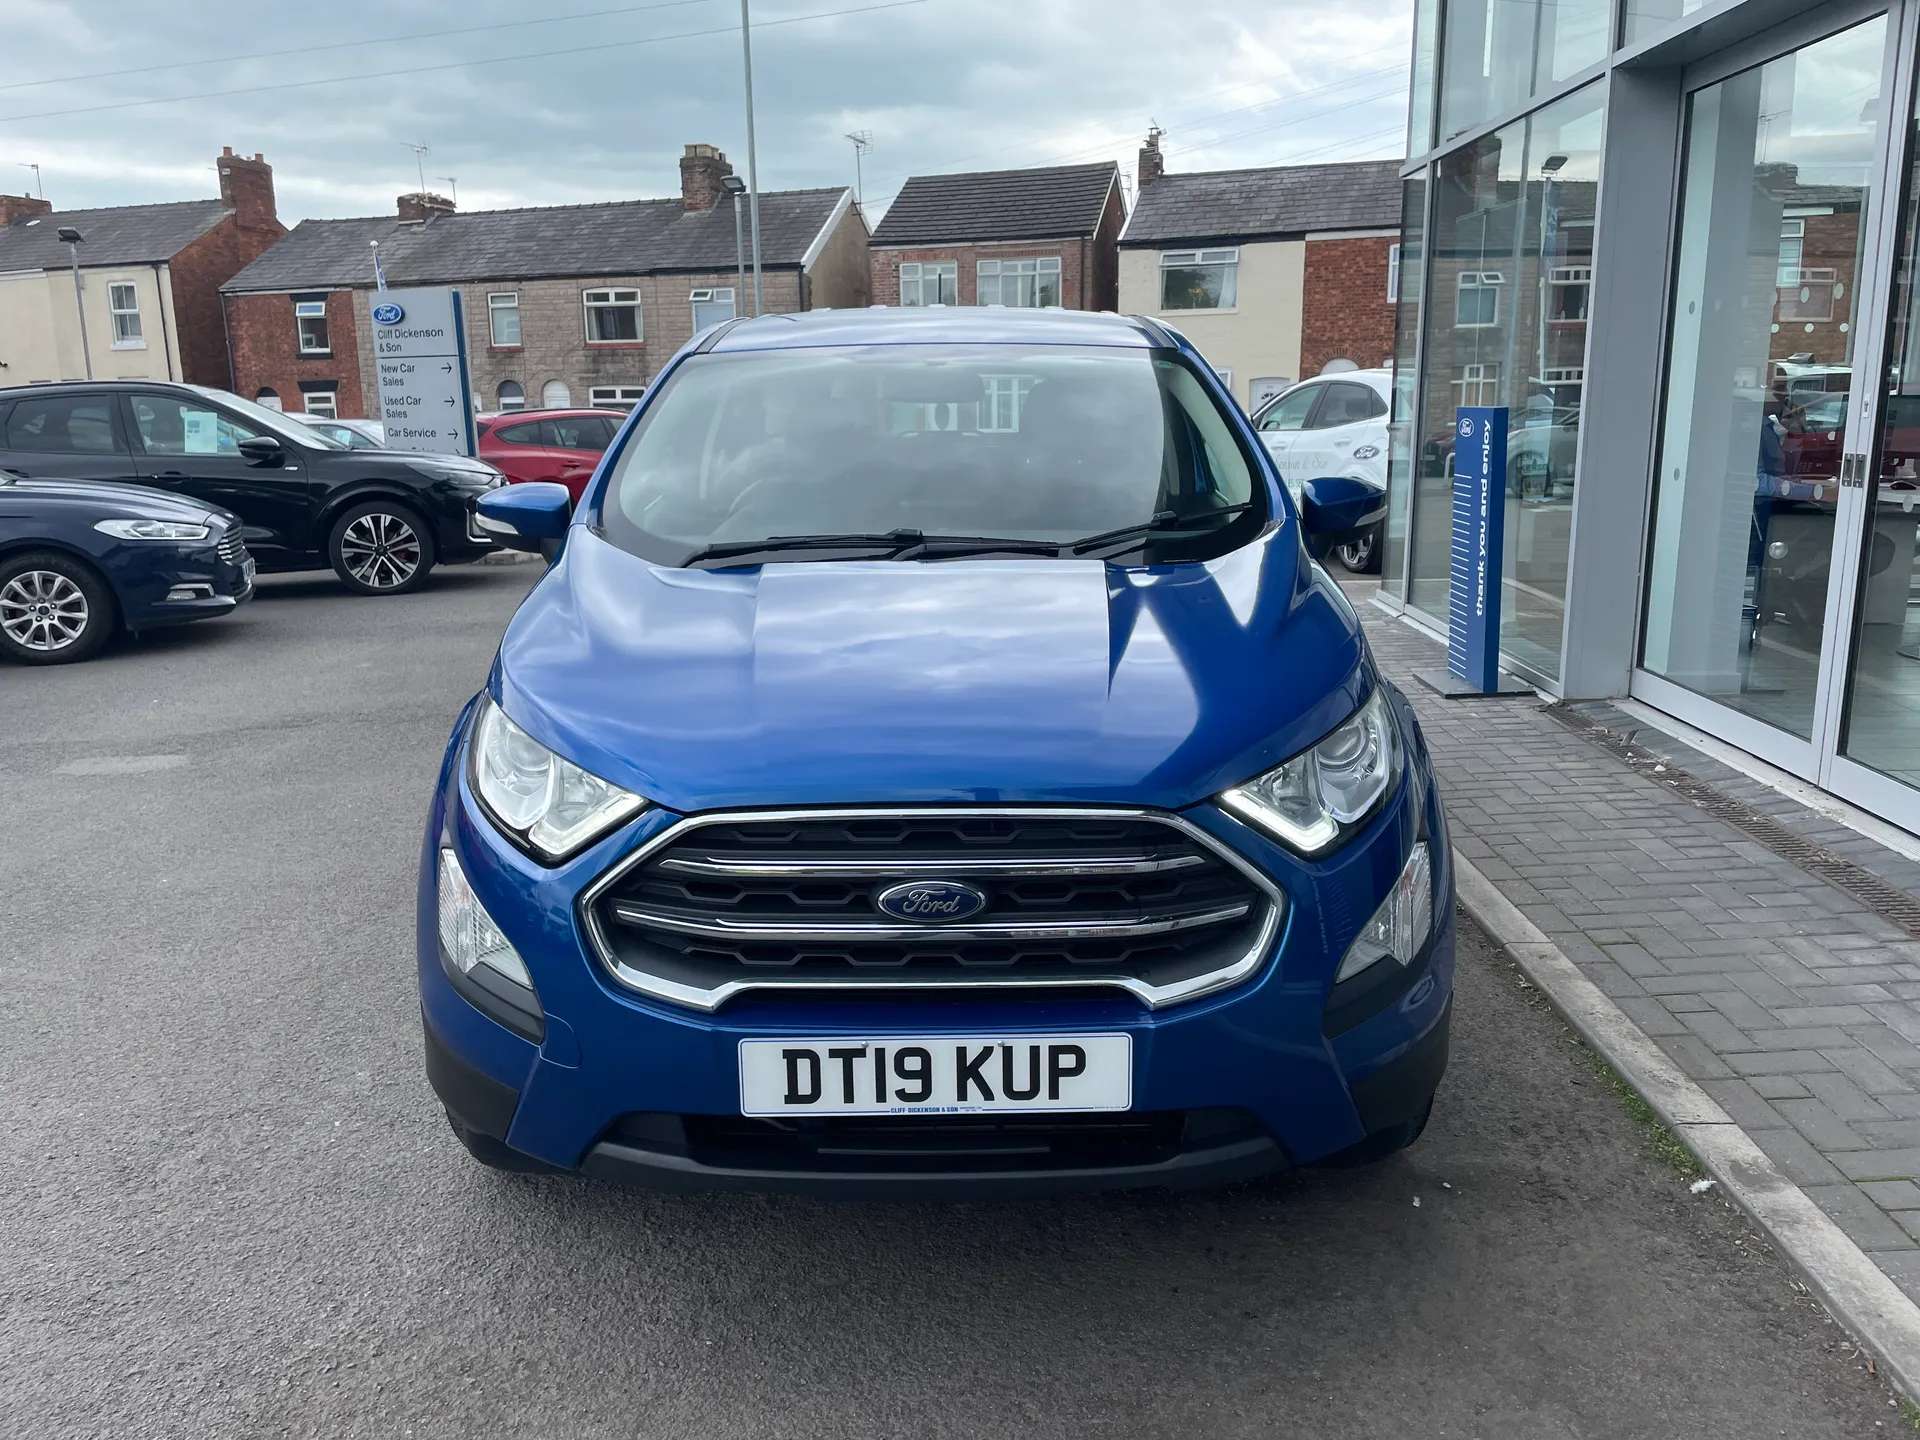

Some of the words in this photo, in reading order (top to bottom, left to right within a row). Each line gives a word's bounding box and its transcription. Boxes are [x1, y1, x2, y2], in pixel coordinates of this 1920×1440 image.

[378, 329, 393, 340] Cliff
[395, 328, 444, 339] Dickenson
[379, 343, 385, 352] &
[386, 342, 402, 353] Son
[381, 364, 399, 373] New
[400, 363, 415, 373] Car
[382, 376, 404, 387] Sales
[384, 395, 404, 406] Used
[406, 395, 422, 406] Car
[386, 408, 408, 419] Sales
[388, 427, 401, 438] Car
[403, 427, 437, 438] Service
[1482, 418, 1491, 475] enjoy
[1480, 478, 1488, 518] and
[1476, 560, 1485, 617] thank
[902, 889, 961, 913] Ford
[782, 1046, 933, 1105] DT19
[956, 1044, 1087, 1102] KUP
